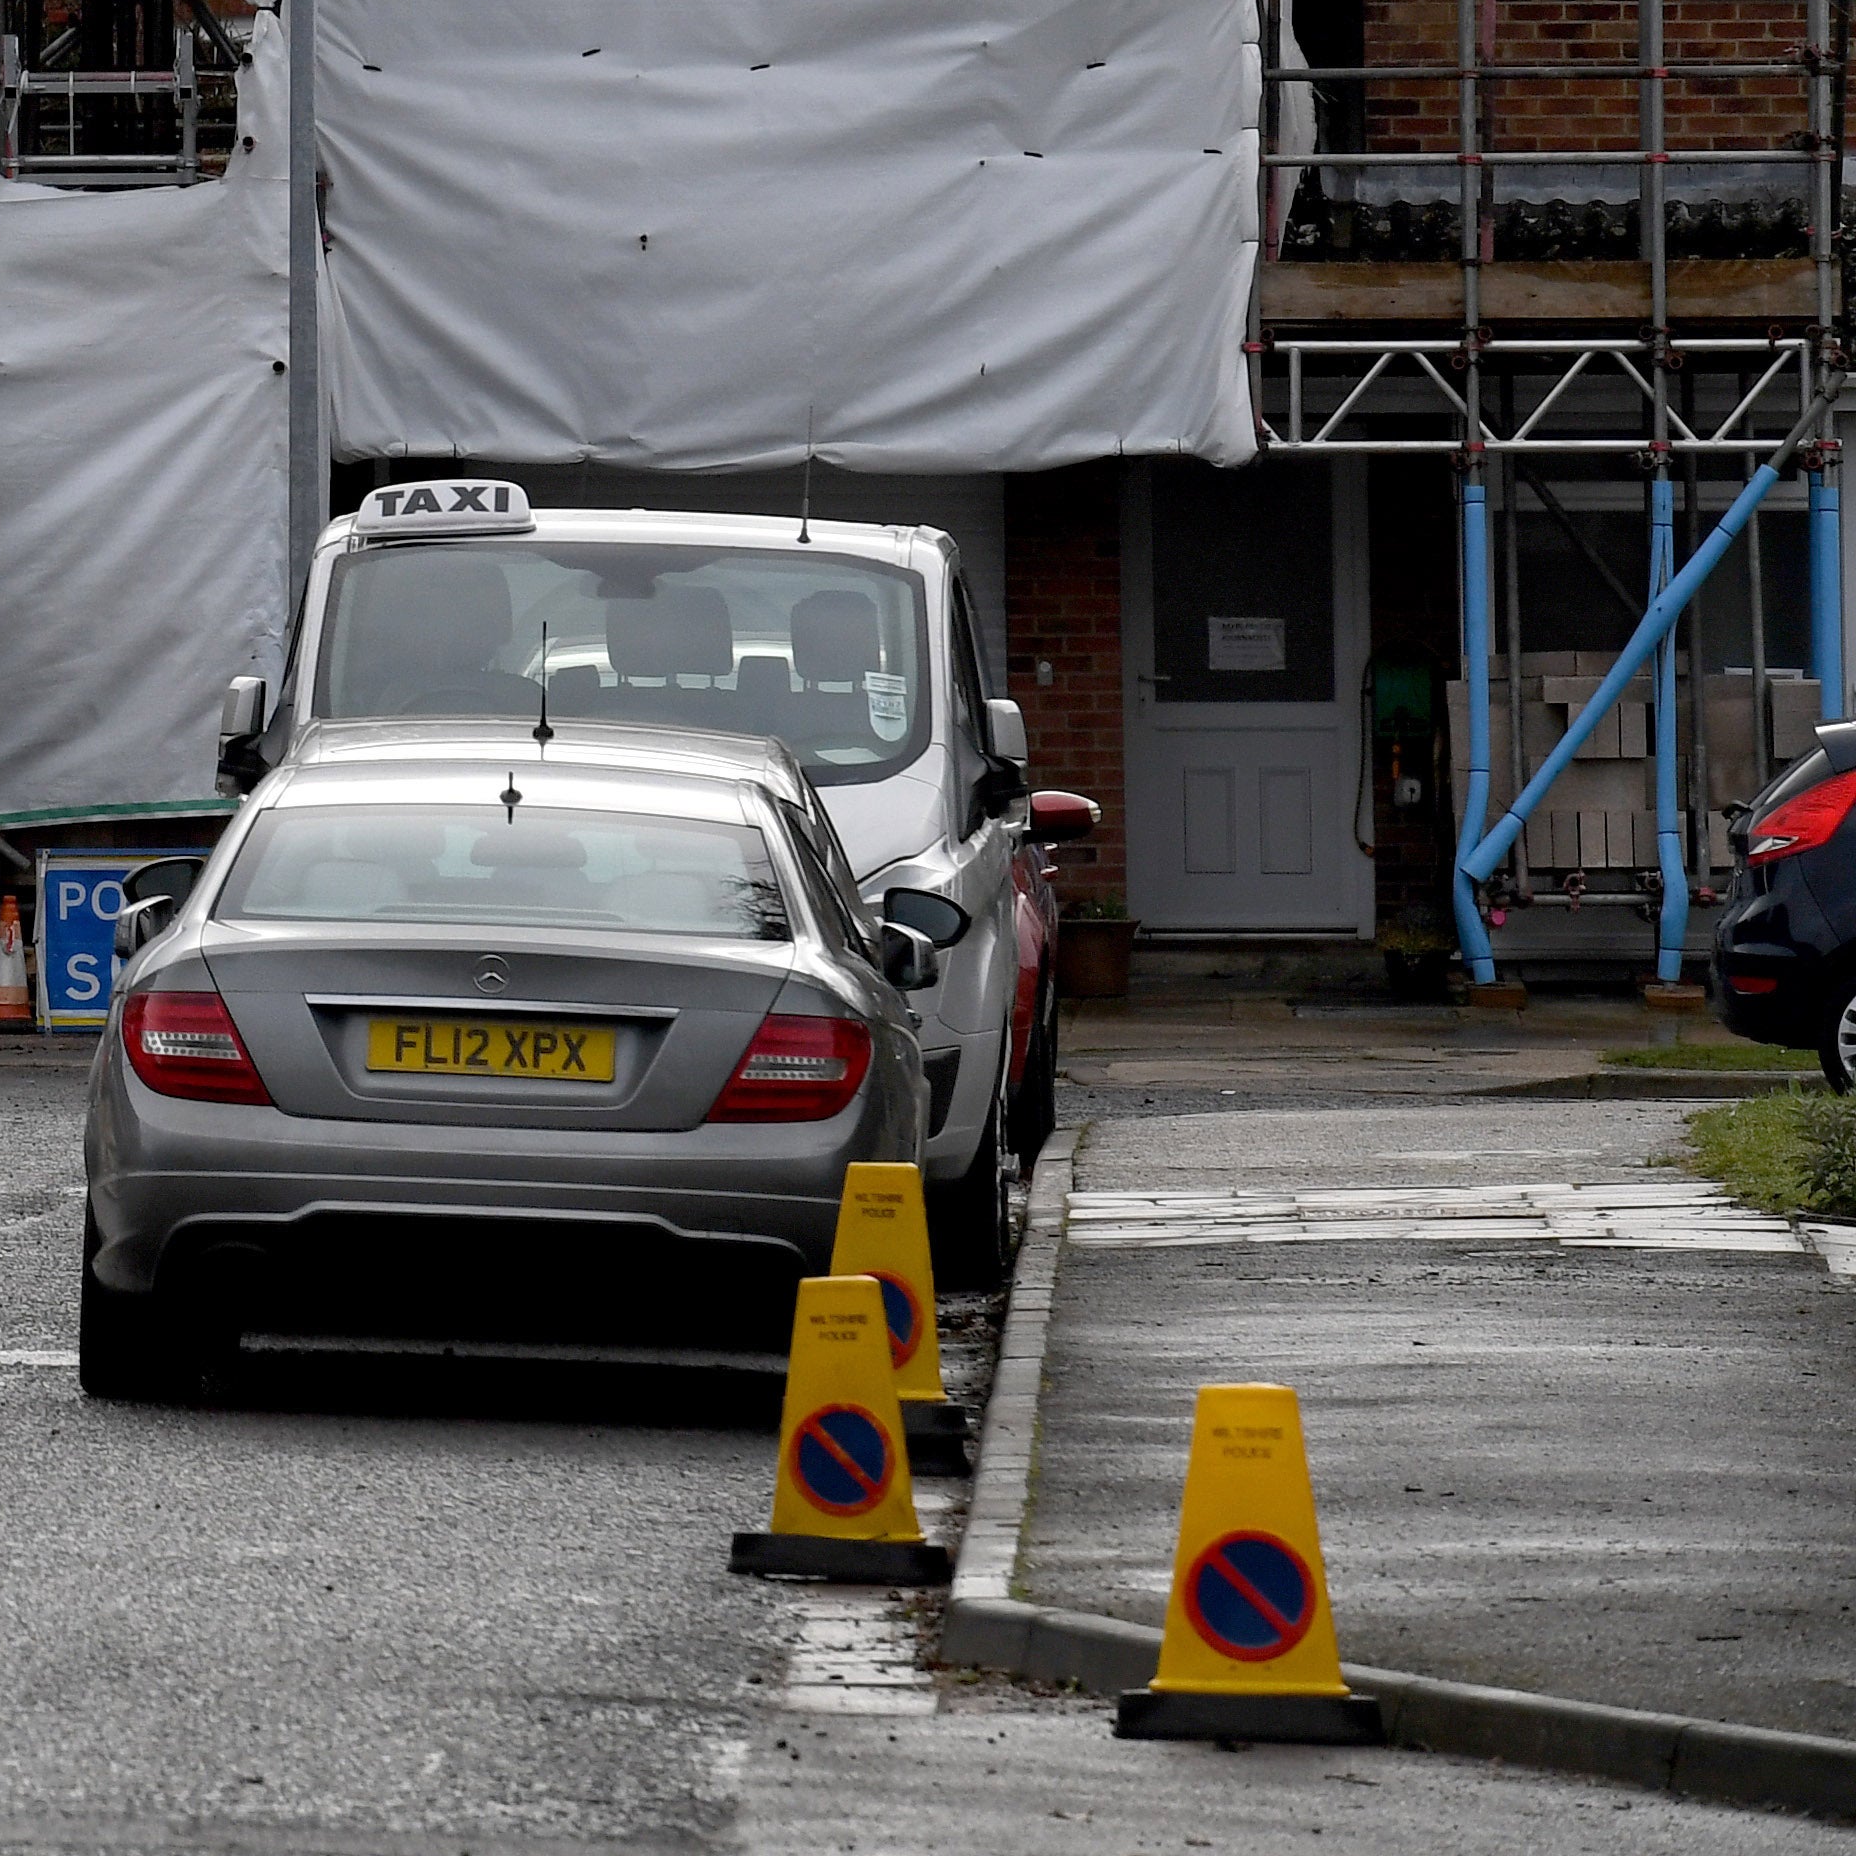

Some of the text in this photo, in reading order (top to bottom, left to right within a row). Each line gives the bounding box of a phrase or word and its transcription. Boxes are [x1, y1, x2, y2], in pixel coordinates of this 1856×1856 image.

[375, 486, 510, 517] TAXI
[394, 1023, 588, 1072] FL12 XPX
